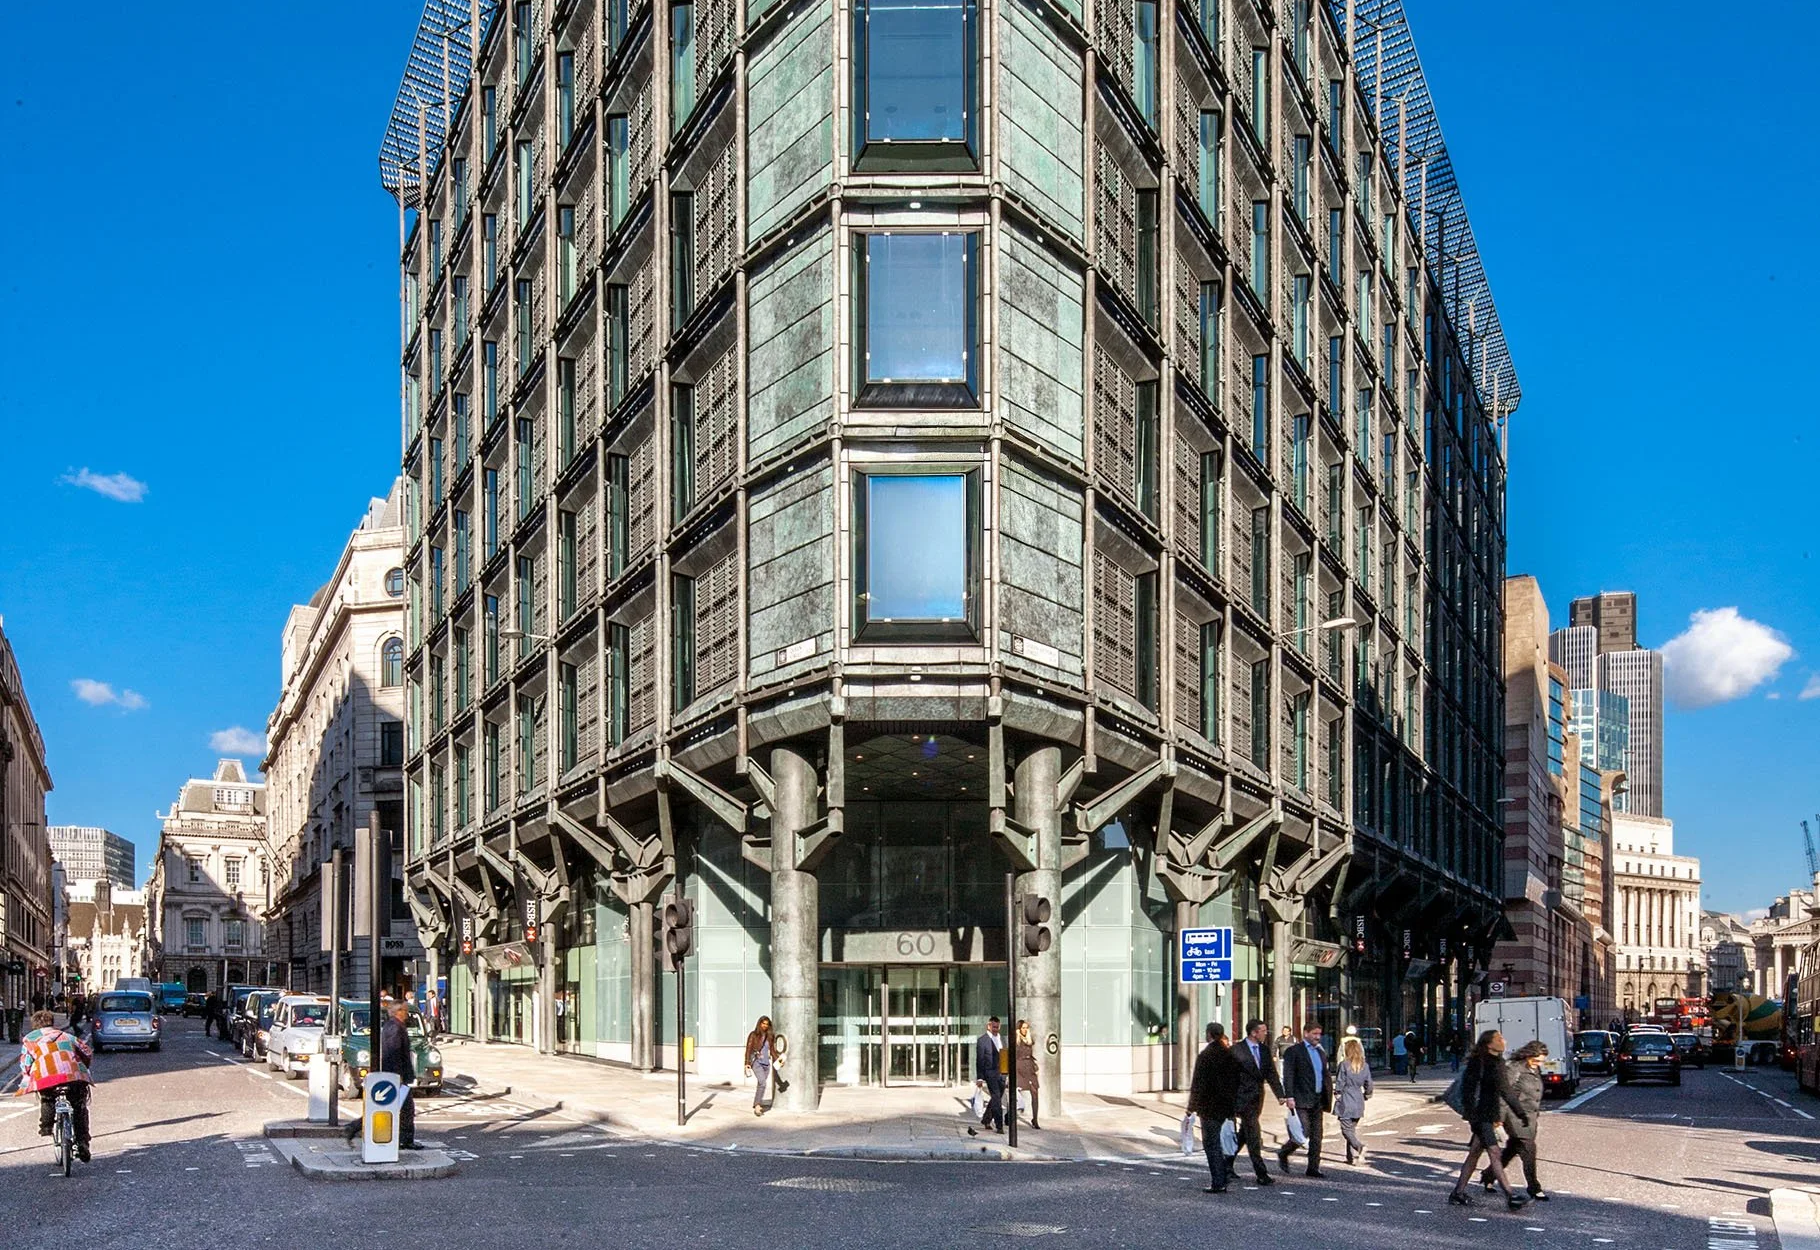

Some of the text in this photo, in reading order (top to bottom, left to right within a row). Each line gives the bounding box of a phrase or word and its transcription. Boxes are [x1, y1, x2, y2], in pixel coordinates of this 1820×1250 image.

[526, 900, 536, 927] HSBC
[462, 918, 472, 941] HSBC
[1356, 915, 1365, 938] HSBC
[385, 940, 405, 949] BOSS
[897, 932, 935, 956] 60
